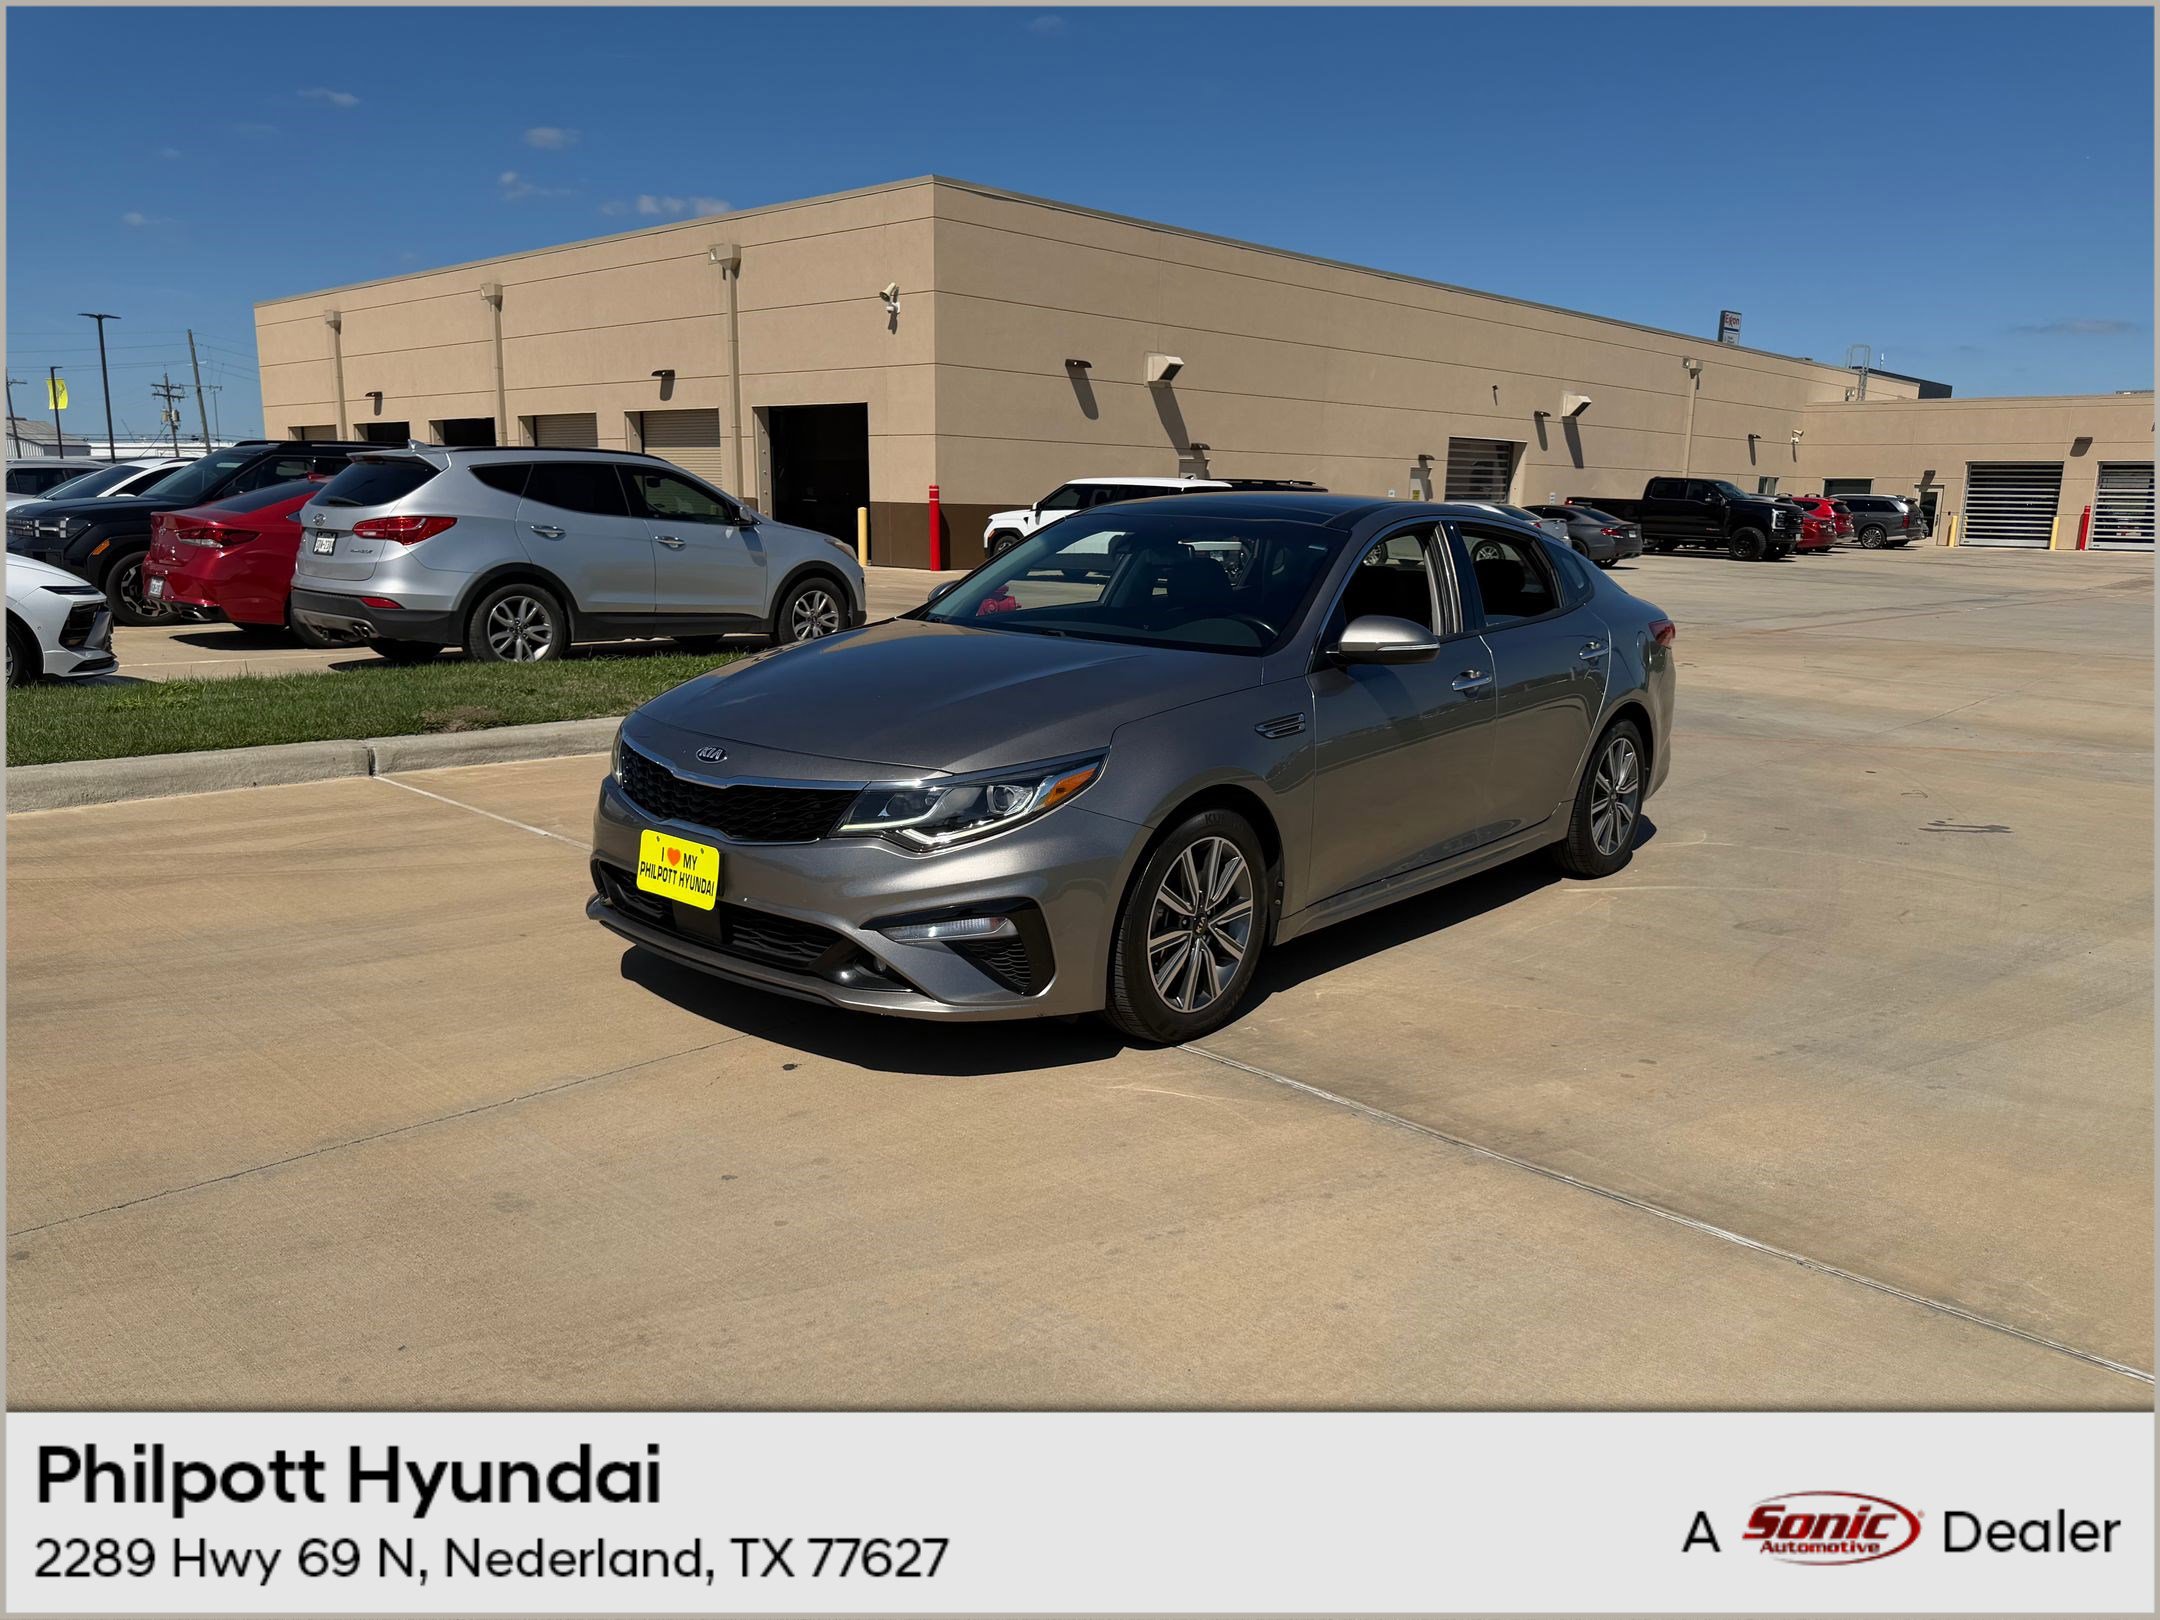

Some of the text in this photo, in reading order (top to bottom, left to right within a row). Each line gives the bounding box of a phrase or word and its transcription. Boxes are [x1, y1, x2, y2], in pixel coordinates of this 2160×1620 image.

[699, 746, 723, 760] KIA
[661, 847, 698, 870] I MY
[640, 861, 715, 896] PHILPOTT HYUNDAI
